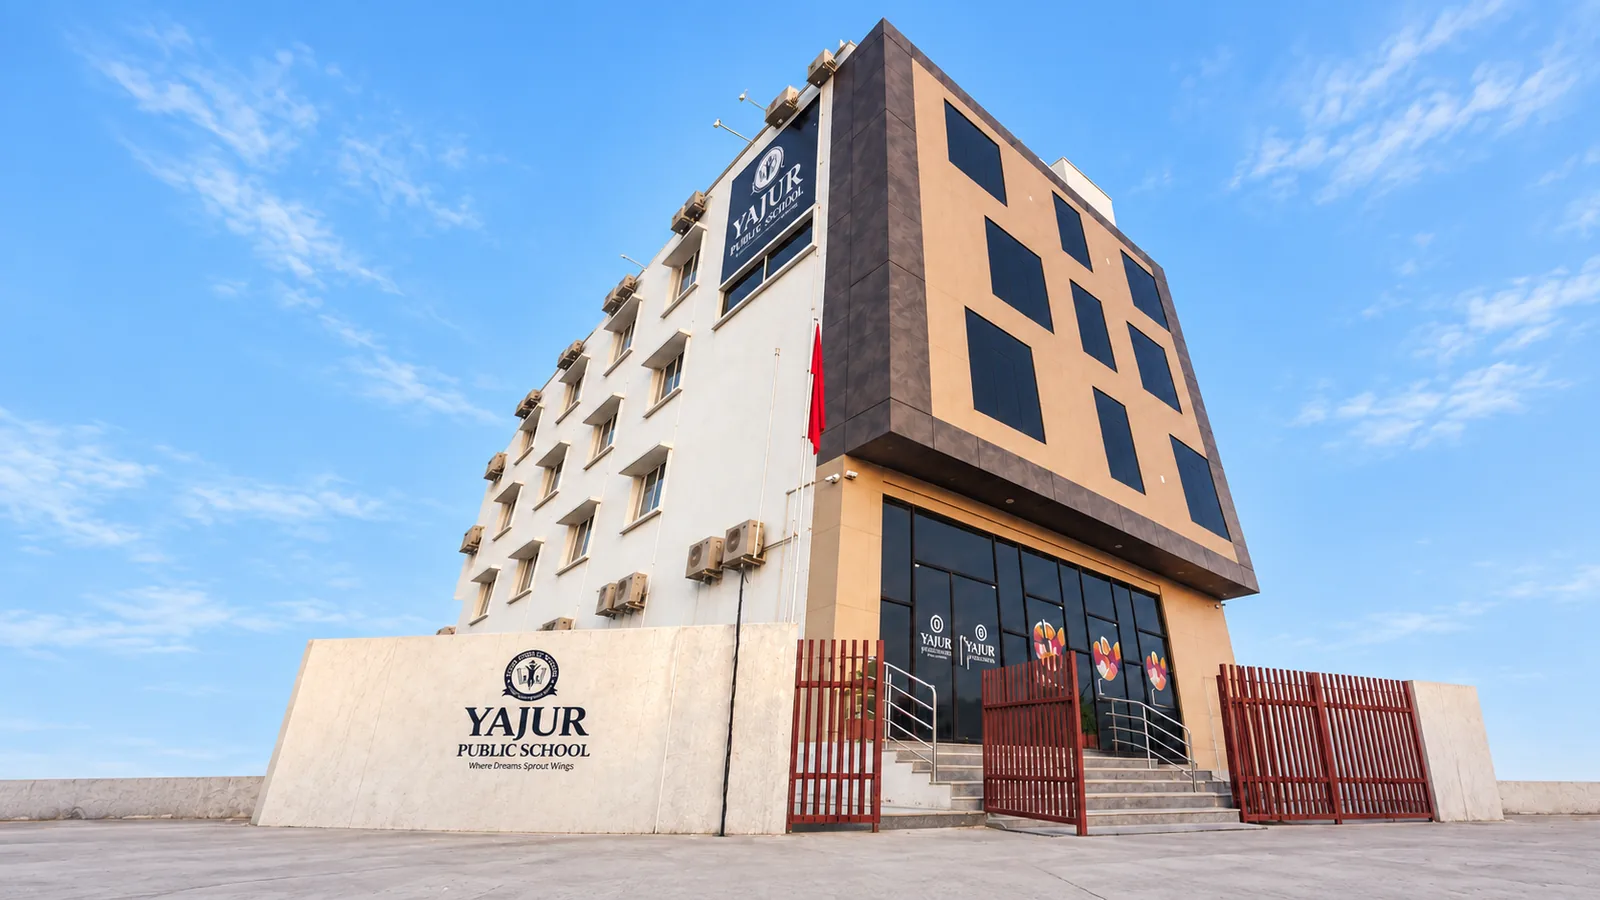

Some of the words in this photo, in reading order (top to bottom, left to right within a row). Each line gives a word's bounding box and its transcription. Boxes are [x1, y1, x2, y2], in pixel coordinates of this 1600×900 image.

[733, 163, 803, 239] YAJUR
[920, 632, 952, 650] YAJUR
[965, 640, 995, 657] YAJUR
[465, 707, 589, 741] YAJUR
[457, 744, 517, 757] PUBLIC
[520, 744, 590, 757] SCHOOL
[468, 762, 492, 770] Where
[493, 762, 522, 770] Dreams
[523, 762, 549, 771] Sprout
[550, 762, 574, 772] Wings
